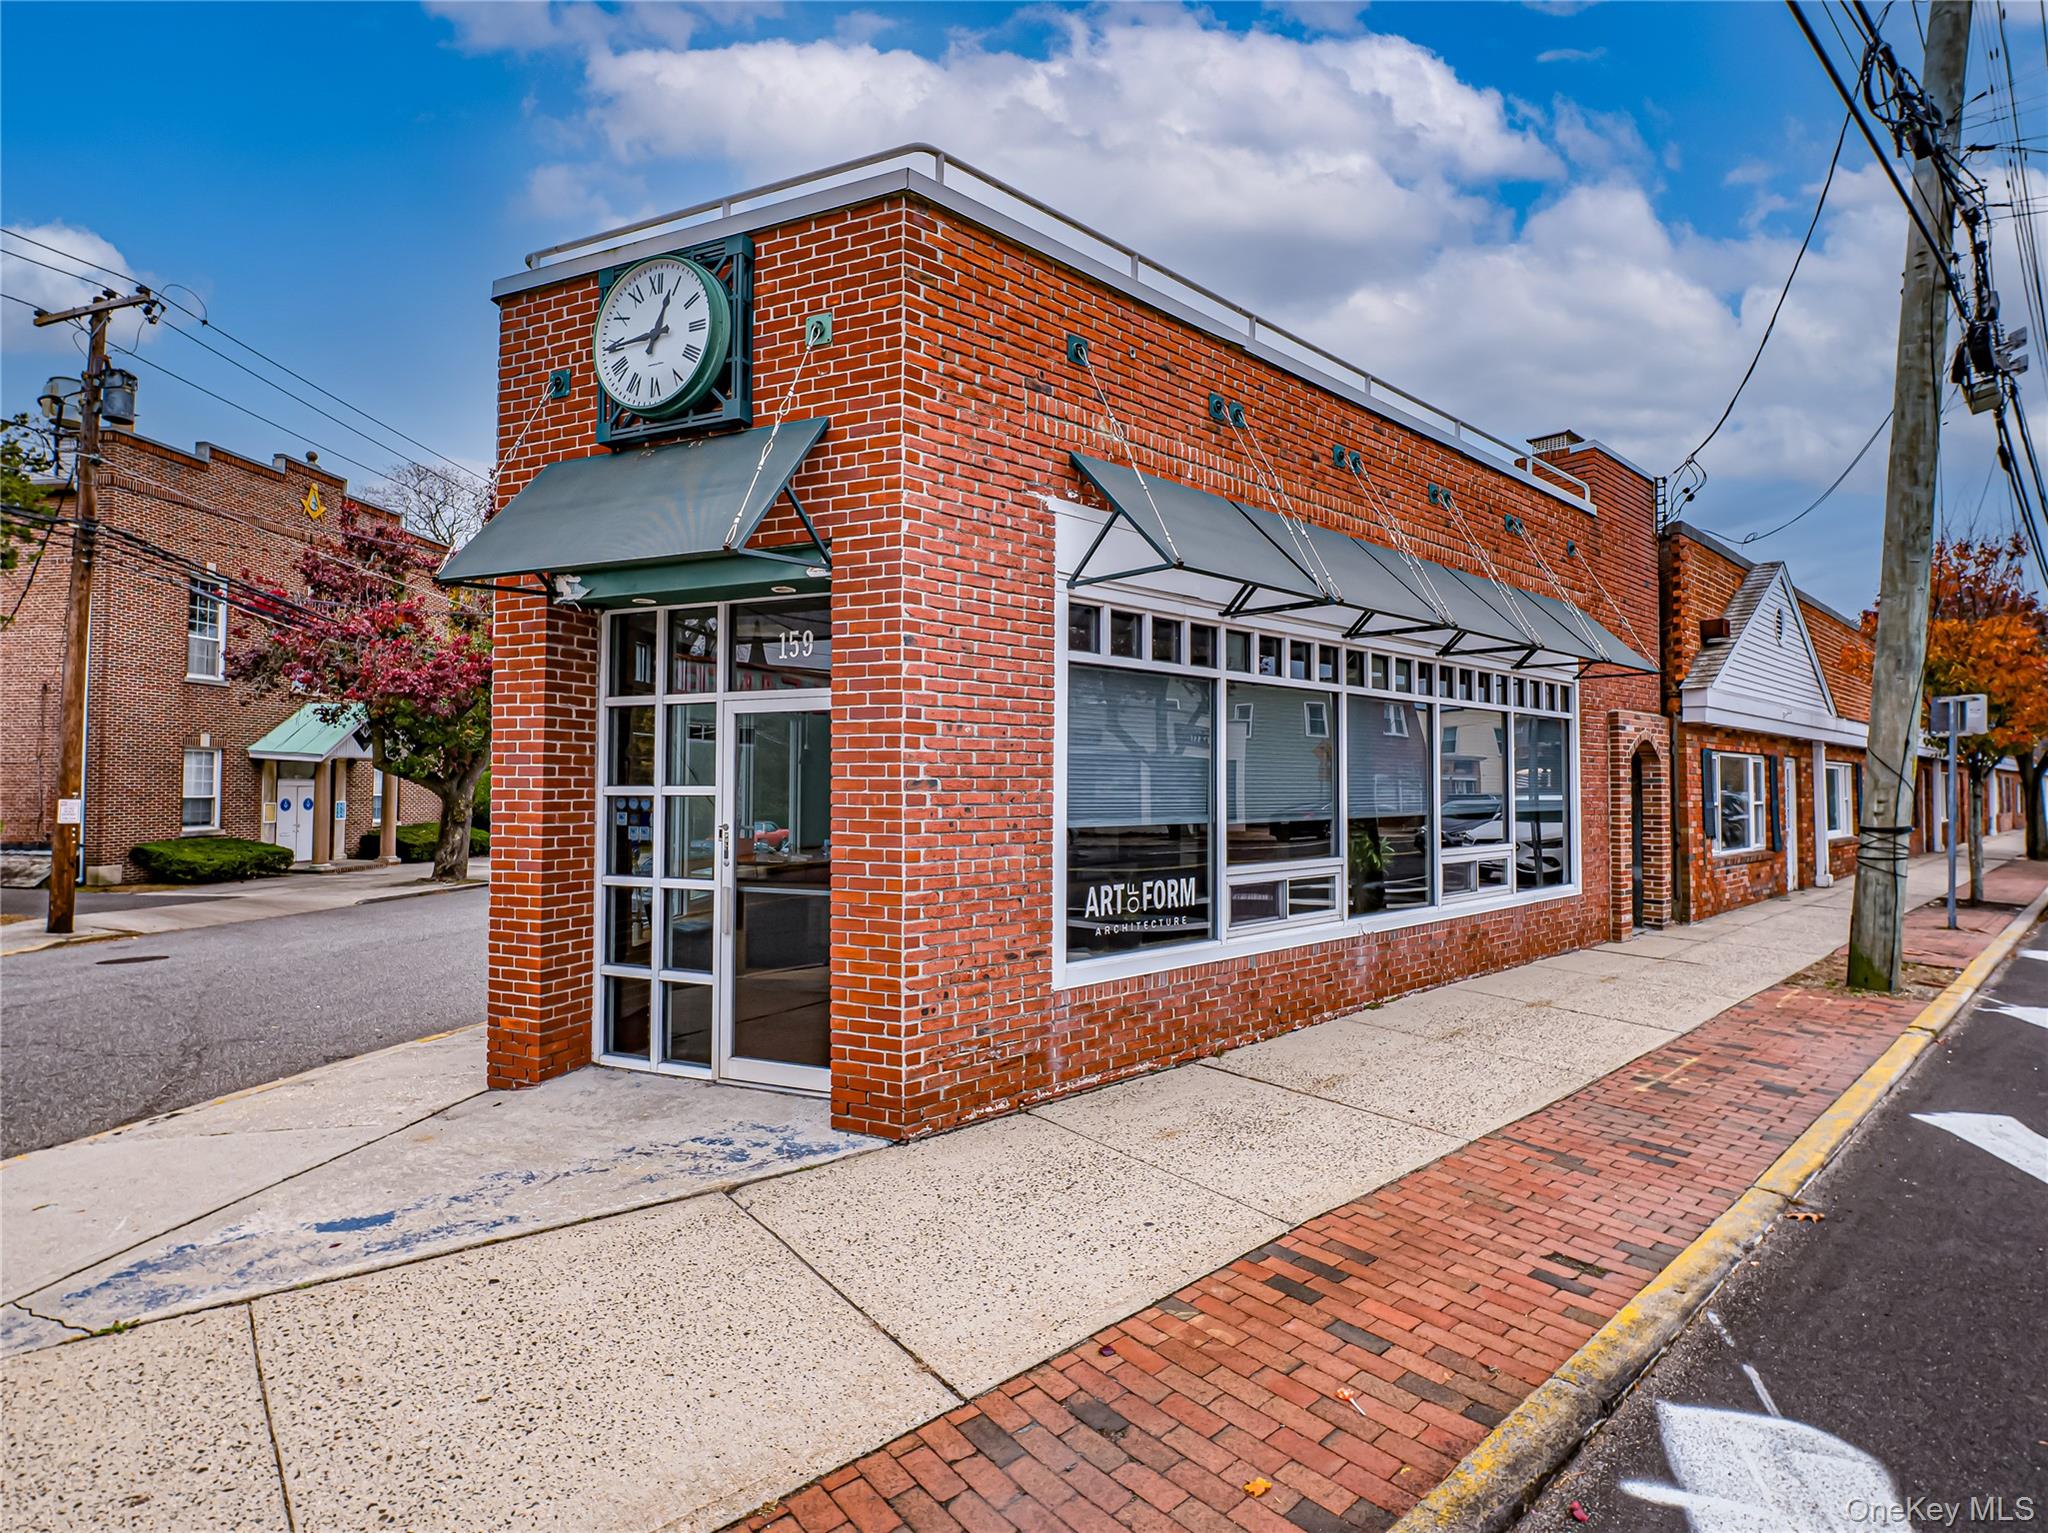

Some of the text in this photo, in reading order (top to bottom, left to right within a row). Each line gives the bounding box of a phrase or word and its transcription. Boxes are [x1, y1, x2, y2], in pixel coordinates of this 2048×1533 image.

[649, 272, 664, 296] XII
[628, 284, 645, 308] XI
[684, 292, 700, 310] II
[613, 311, 631, 327] X
[689, 319, 706, 332] III
[611, 356, 629, 382] VIII
[672, 368, 684, 387] V
[626, 372, 642, 397] VII
[650, 377, 661, 399] VI
[778, 629, 814, 659] 159
[1084, 877, 1196, 918] ART OF FORM
[1095, 915, 1188, 936] ARCHITECTURE
